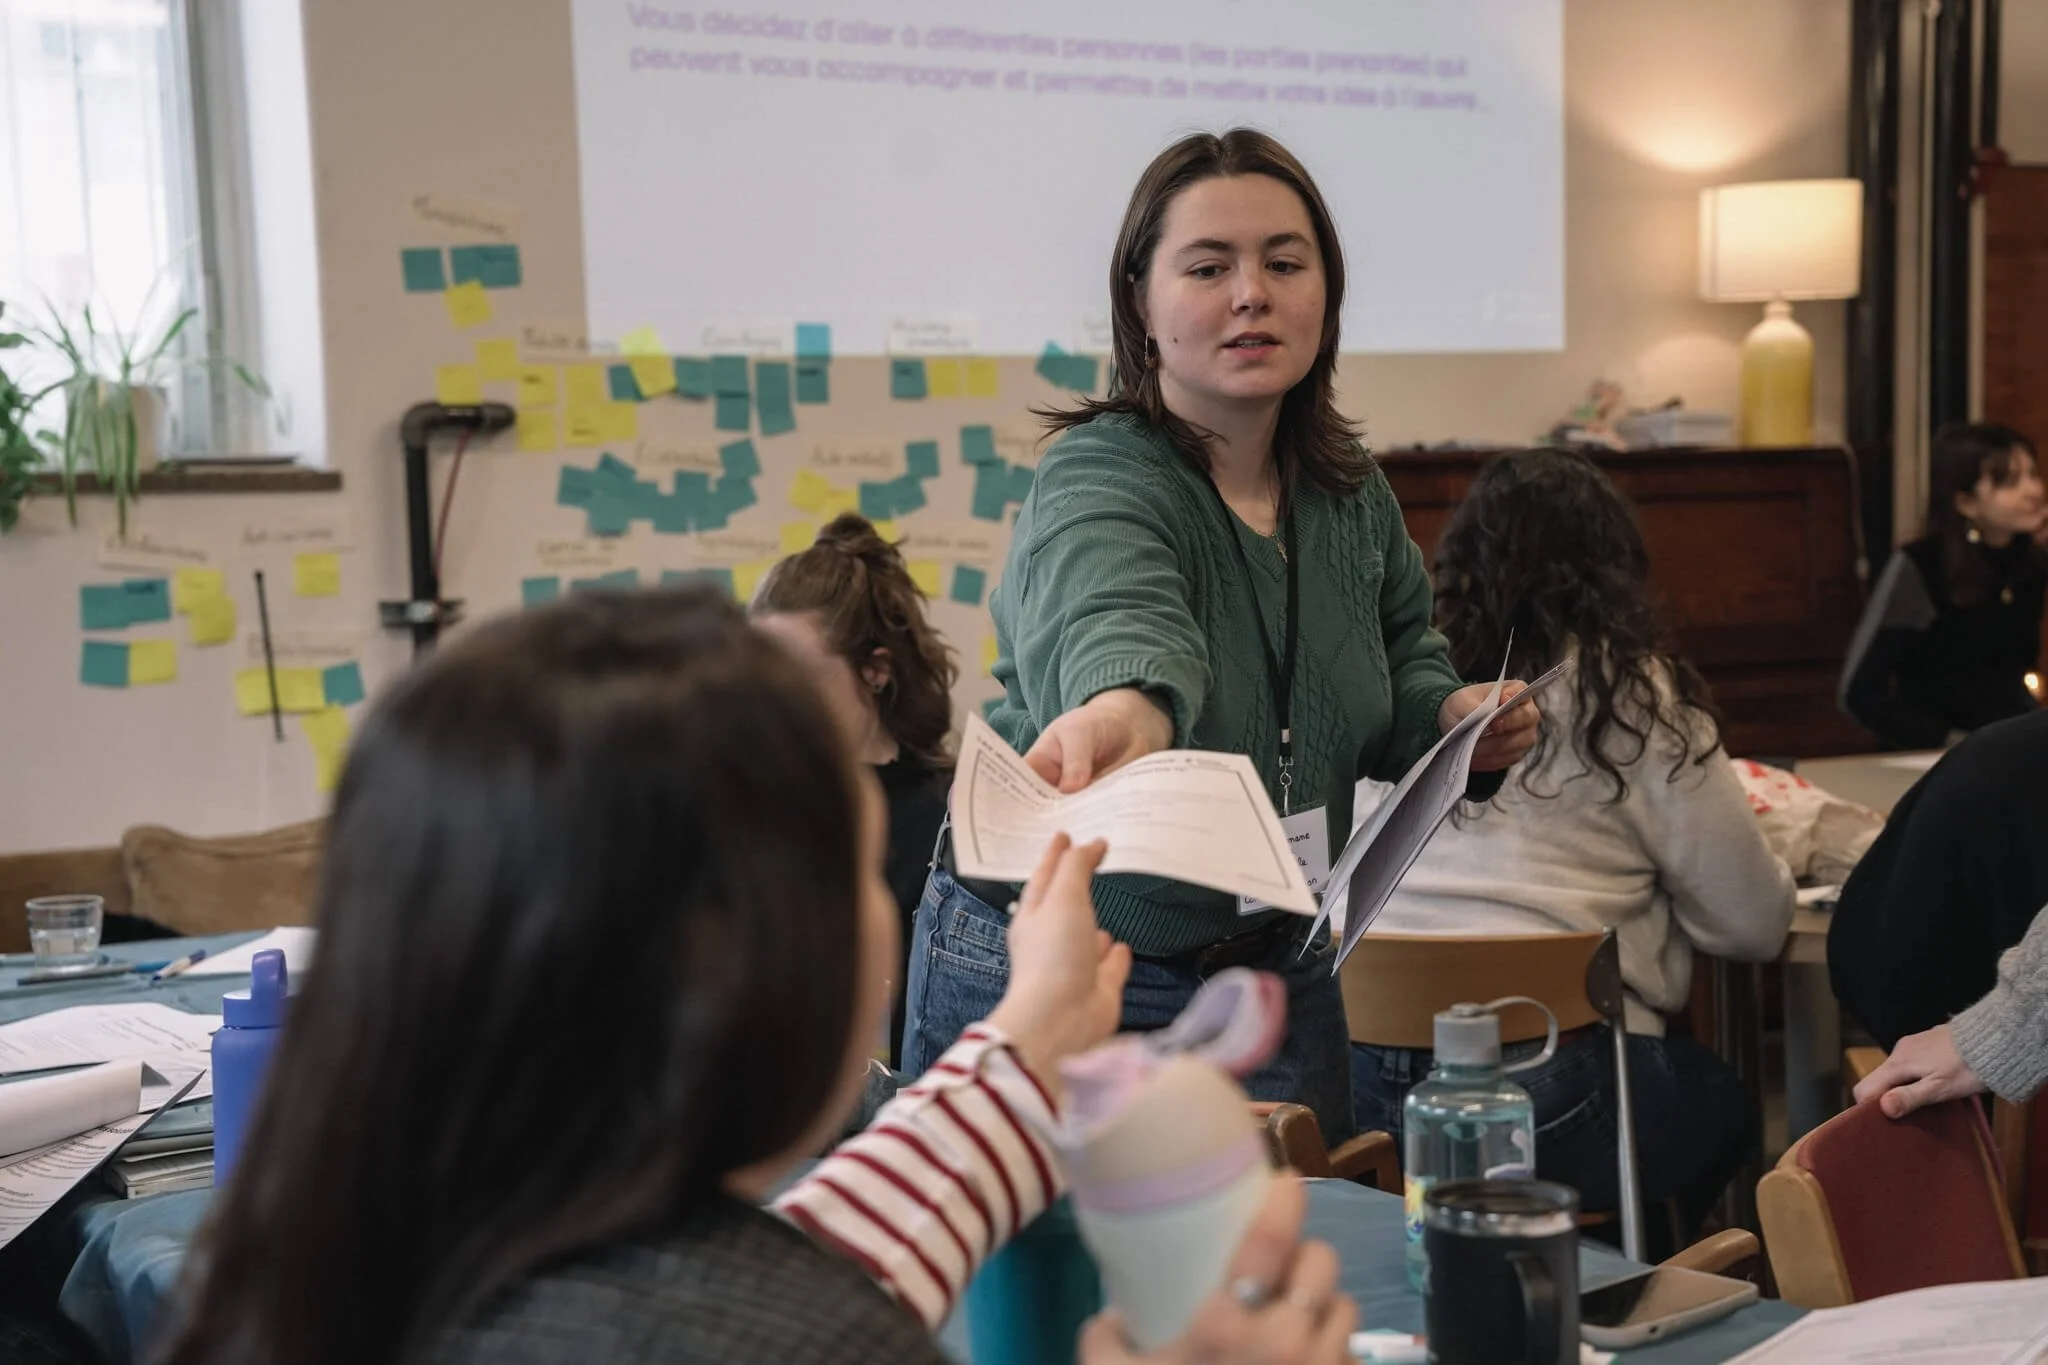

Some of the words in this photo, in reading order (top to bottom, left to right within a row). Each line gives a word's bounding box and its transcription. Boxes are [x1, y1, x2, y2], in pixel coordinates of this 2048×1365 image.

[628, 3, 697, 33] Vous
[701, 12, 809, 41] décidez
[814, 19, 897, 46] d'aller
[901, 25, 922, 48] à
[924, 27, 1060, 57] différentes
[1062, 38, 1186, 63] personnes
[1233, 47, 1313, 69] parties
[1435, 56, 1470, 78] qui
[630, 47, 744, 76] peuvent
[749, 58, 813, 80] vous
[817, 61, 998, 92] accompagner
[1003, 71, 1030, 93] et
[1034, 75, 1157, 100] permettre
[1158, 79, 1191, 100] de
[1193, 82, 1271, 103] mettre
